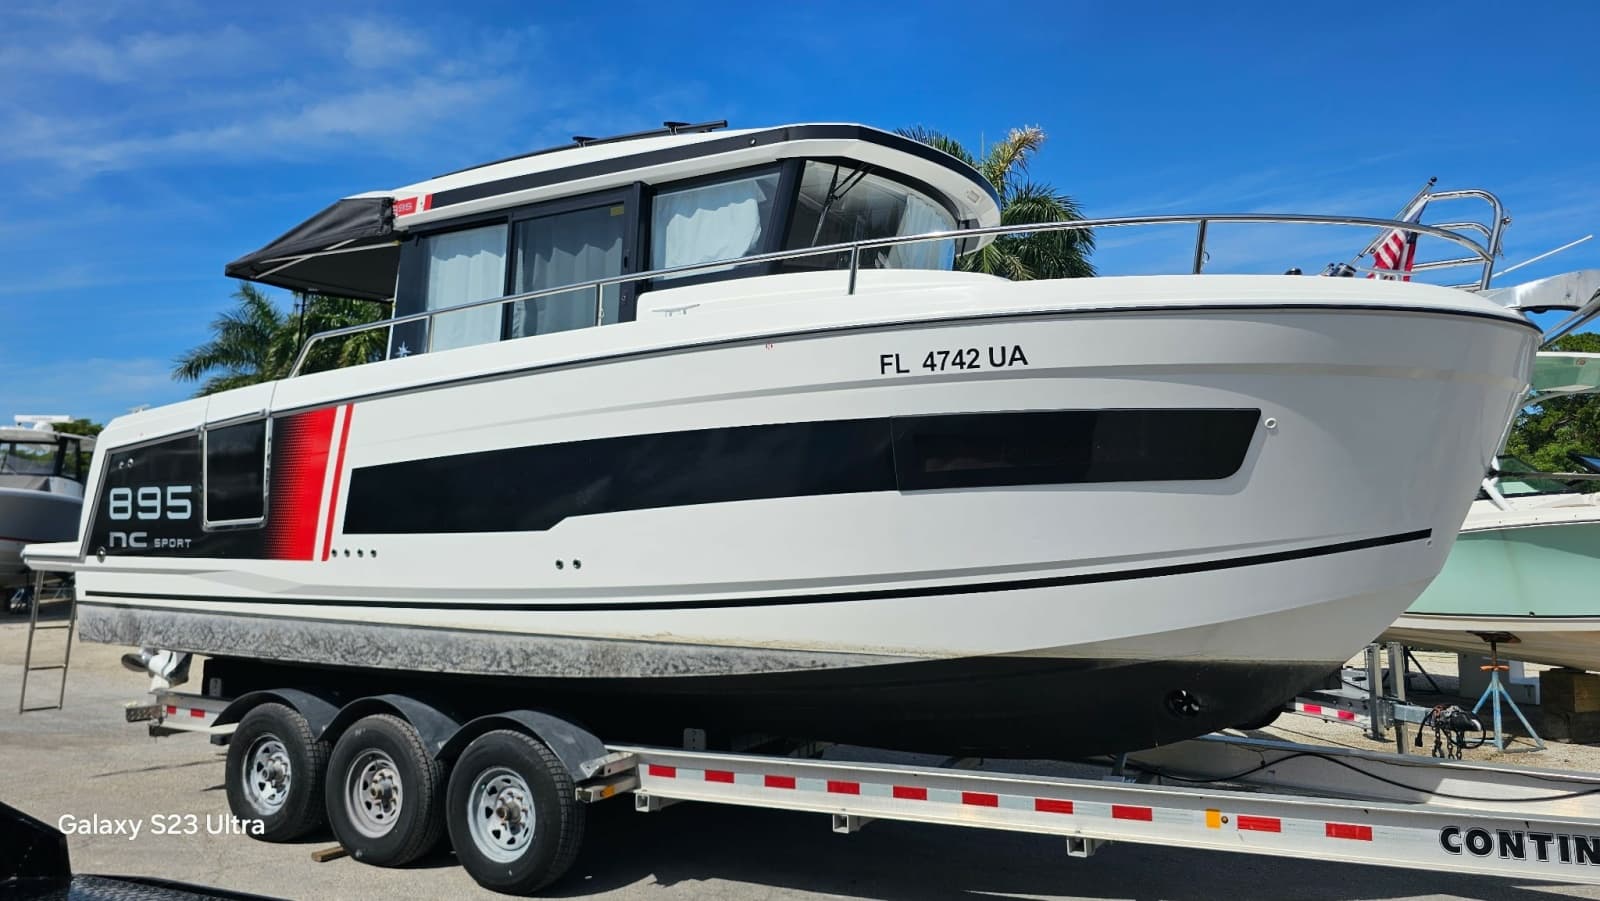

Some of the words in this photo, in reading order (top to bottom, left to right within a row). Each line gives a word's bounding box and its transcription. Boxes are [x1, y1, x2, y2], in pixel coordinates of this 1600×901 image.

[880, 353, 910, 374] FL
[922, 348, 981, 371] 4742
[988, 345, 1029, 367] UA
[109, 485, 192, 520] 895
[154, 538, 192, 549] SPORT
[1439, 825, 1600, 866] CONTIN
